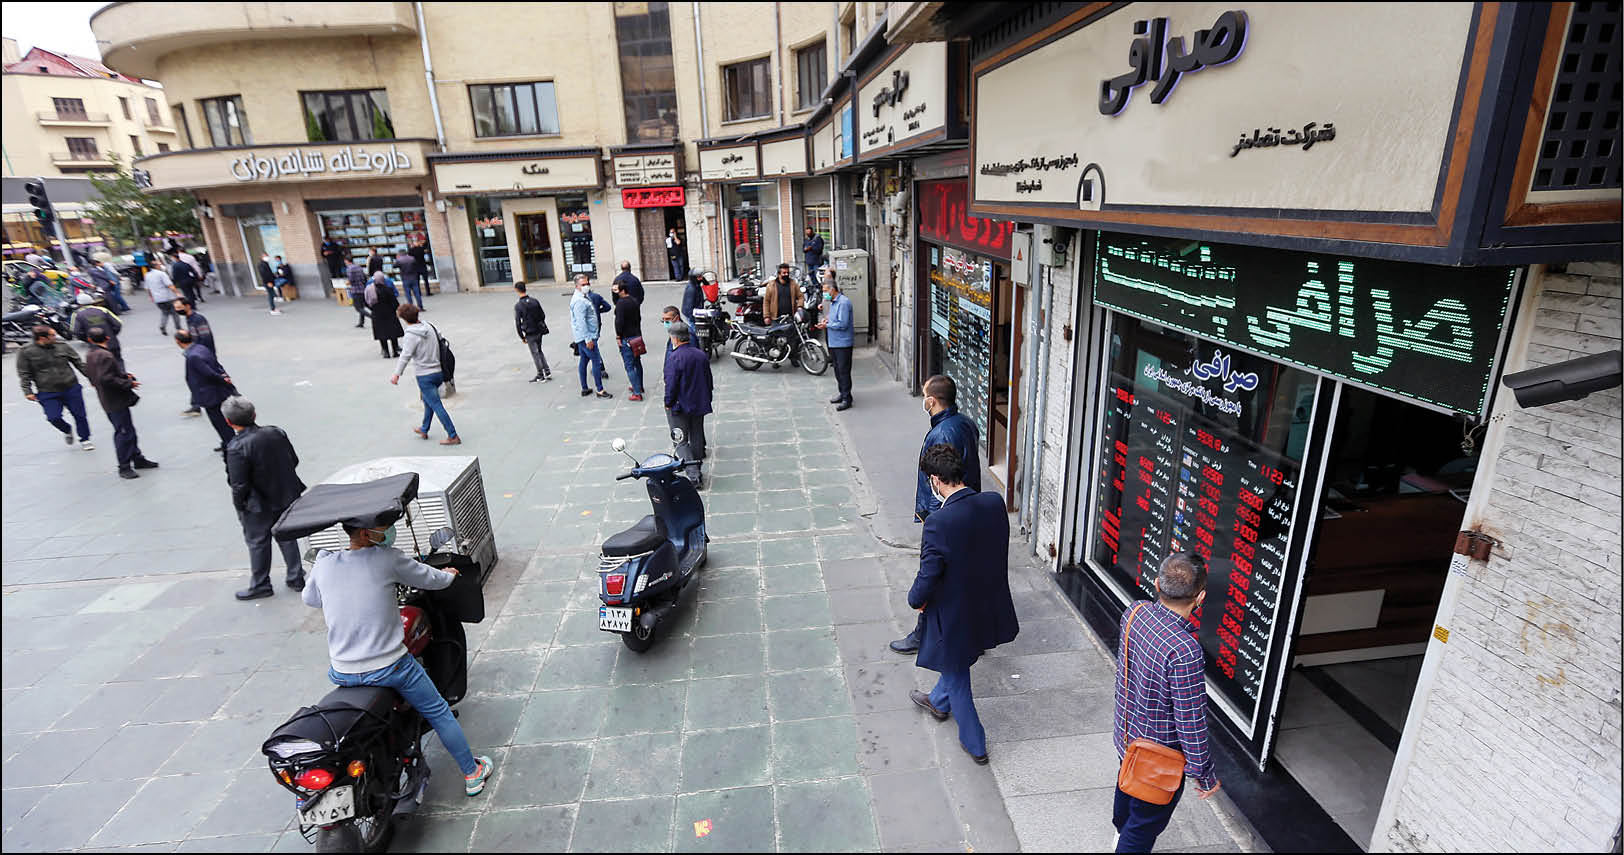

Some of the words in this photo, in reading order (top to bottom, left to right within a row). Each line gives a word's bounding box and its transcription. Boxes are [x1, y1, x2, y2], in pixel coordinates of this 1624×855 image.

[1097, 9, 1251, 117] صرافی
[1280, 122, 1336, 151] شرکت
[231, 152, 280, 182] روزی
[278, 148, 325, 177] شبانه
[330, 144, 411, 175] داروخانه
[522, 163, 550, 176] سکه
[1247, 261, 1473, 374] صرافی
[1192, 349, 1259, 392] صرافی
